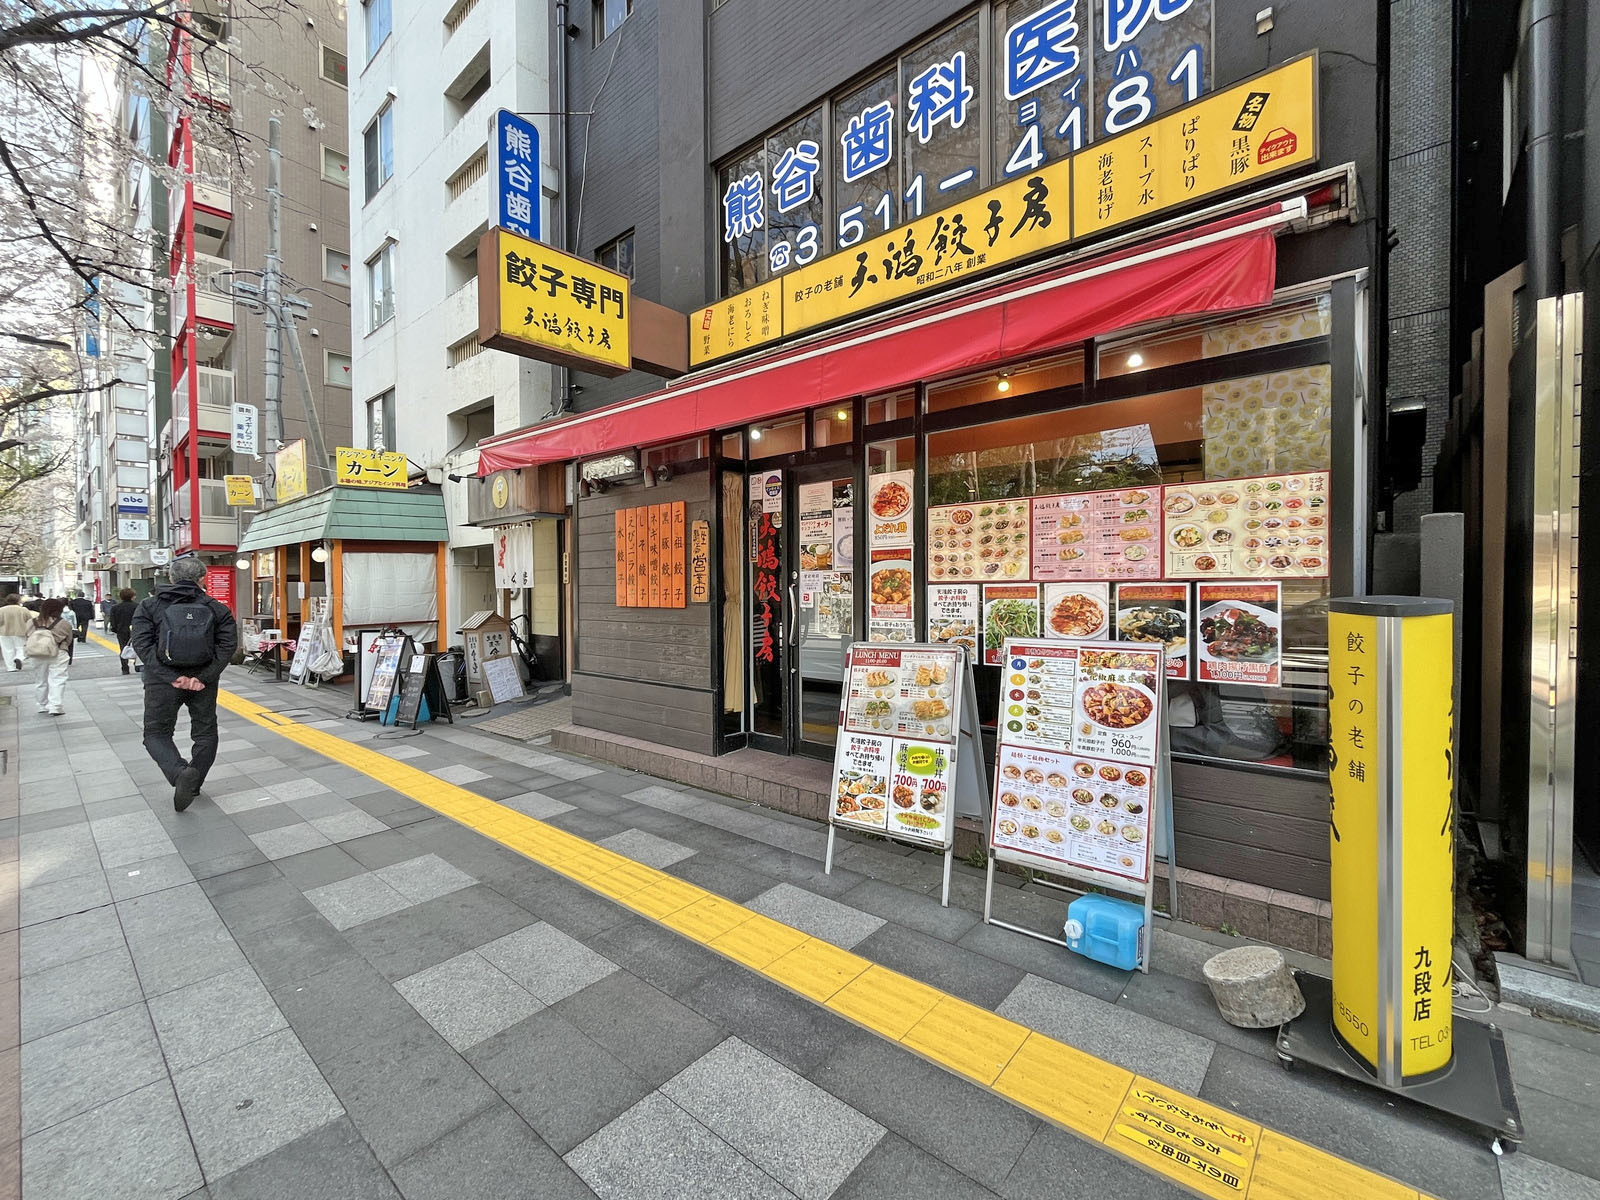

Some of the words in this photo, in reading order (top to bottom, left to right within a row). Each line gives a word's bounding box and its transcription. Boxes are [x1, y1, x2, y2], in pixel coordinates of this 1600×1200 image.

[1236, 95, 1264, 130] 名物
[1182, 115, 1200, 192] ぱりぱり
[1230, 135, 1250, 177] 黒豚
[1259, 138, 1294, 154] テイクアウト
[1260, 146, 1294, 162] 出来ます
[1097, 151, 1114, 220] 海老揚げ
[1137, 135, 1155, 206] スープ水
[848, 177, 1053, 298] 天鴻餃子房
[504, 251, 624, 320] 餃子専門
[794, 274, 844, 303] 餃子の老舗
[916, 260, 963, 285] 昭和二八年
[966, 252, 987, 268] 創業
[523, 306, 612, 350] 天鴻餃子房
[761, 290, 770, 336] ねぎ味噌
[703, 335, 711, 356] 野菜
[346, 460, 399, 477] カーン
[122, 495, 143, 504] abc
[230, 489, 251, 497] カーン
[616, 527, 625, 585] 水餃子
[638, 516, 647, 600] しそ餃子
[661, 511, 671, 600] 黒豚餃子
[673, 510, 683, 600] 元祖餃子
[692, 553, 707, 597] 営業中
[855, 651, 877, 659] LUNCH
[878, 651, 899, 660] MENU
[1346, 631, 1366, 783] 餃子の老舗
[1413, 946, 1432, 1022] 九段店
[1333, 991, 1369, 1037] -8550
[1410, 1035, 1435, 1051] TEL
[1147, 1138, 1239, 1188] 目の不自由な
